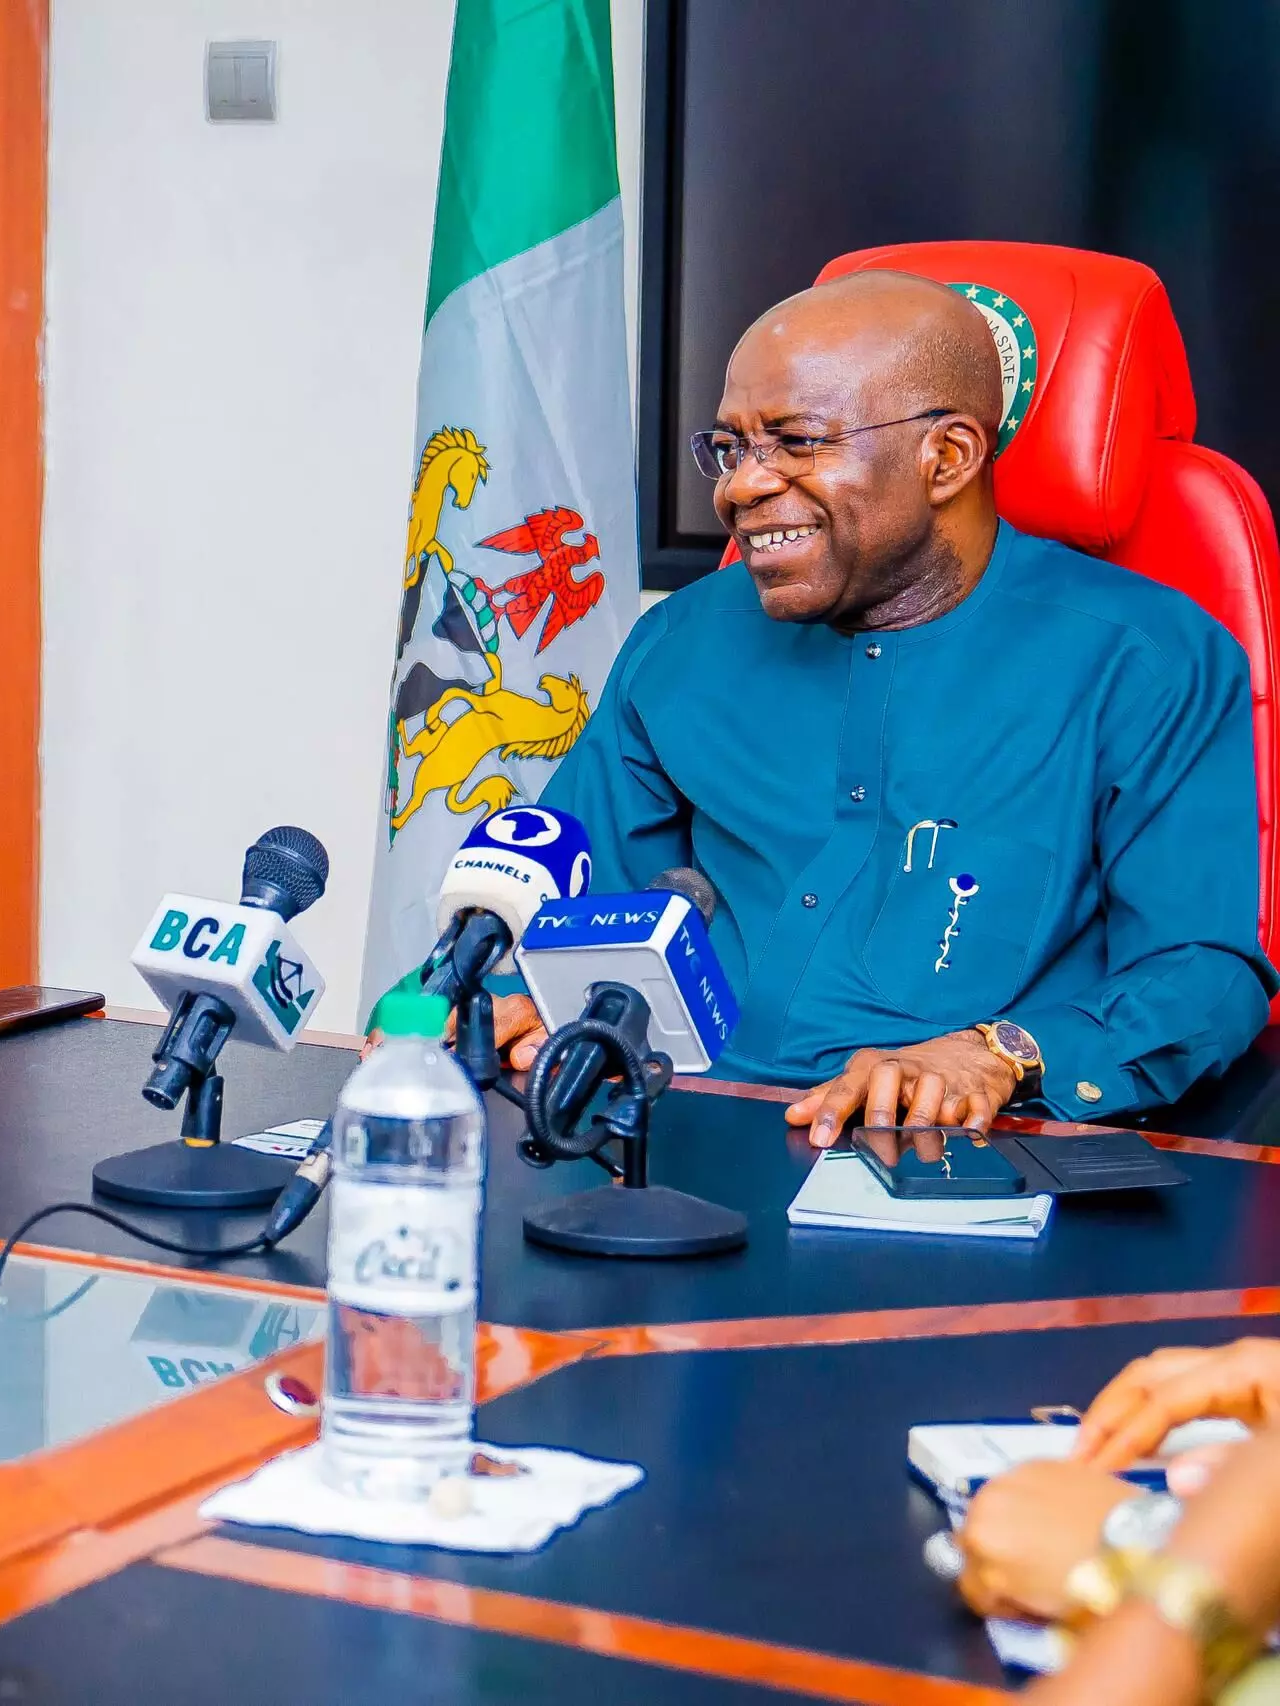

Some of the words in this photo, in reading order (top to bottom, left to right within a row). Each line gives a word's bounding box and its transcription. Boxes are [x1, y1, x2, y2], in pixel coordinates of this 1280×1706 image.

[988, 319, 1000, 337] IA
[996, 335, 1015, 385] STATE
[454, 859, 532, 884] CHANNELS
[149, 909, 247, 966] BCA
[590, 910, 659, 926] NEWS
[698, 978, 729, 1042] NEWS
